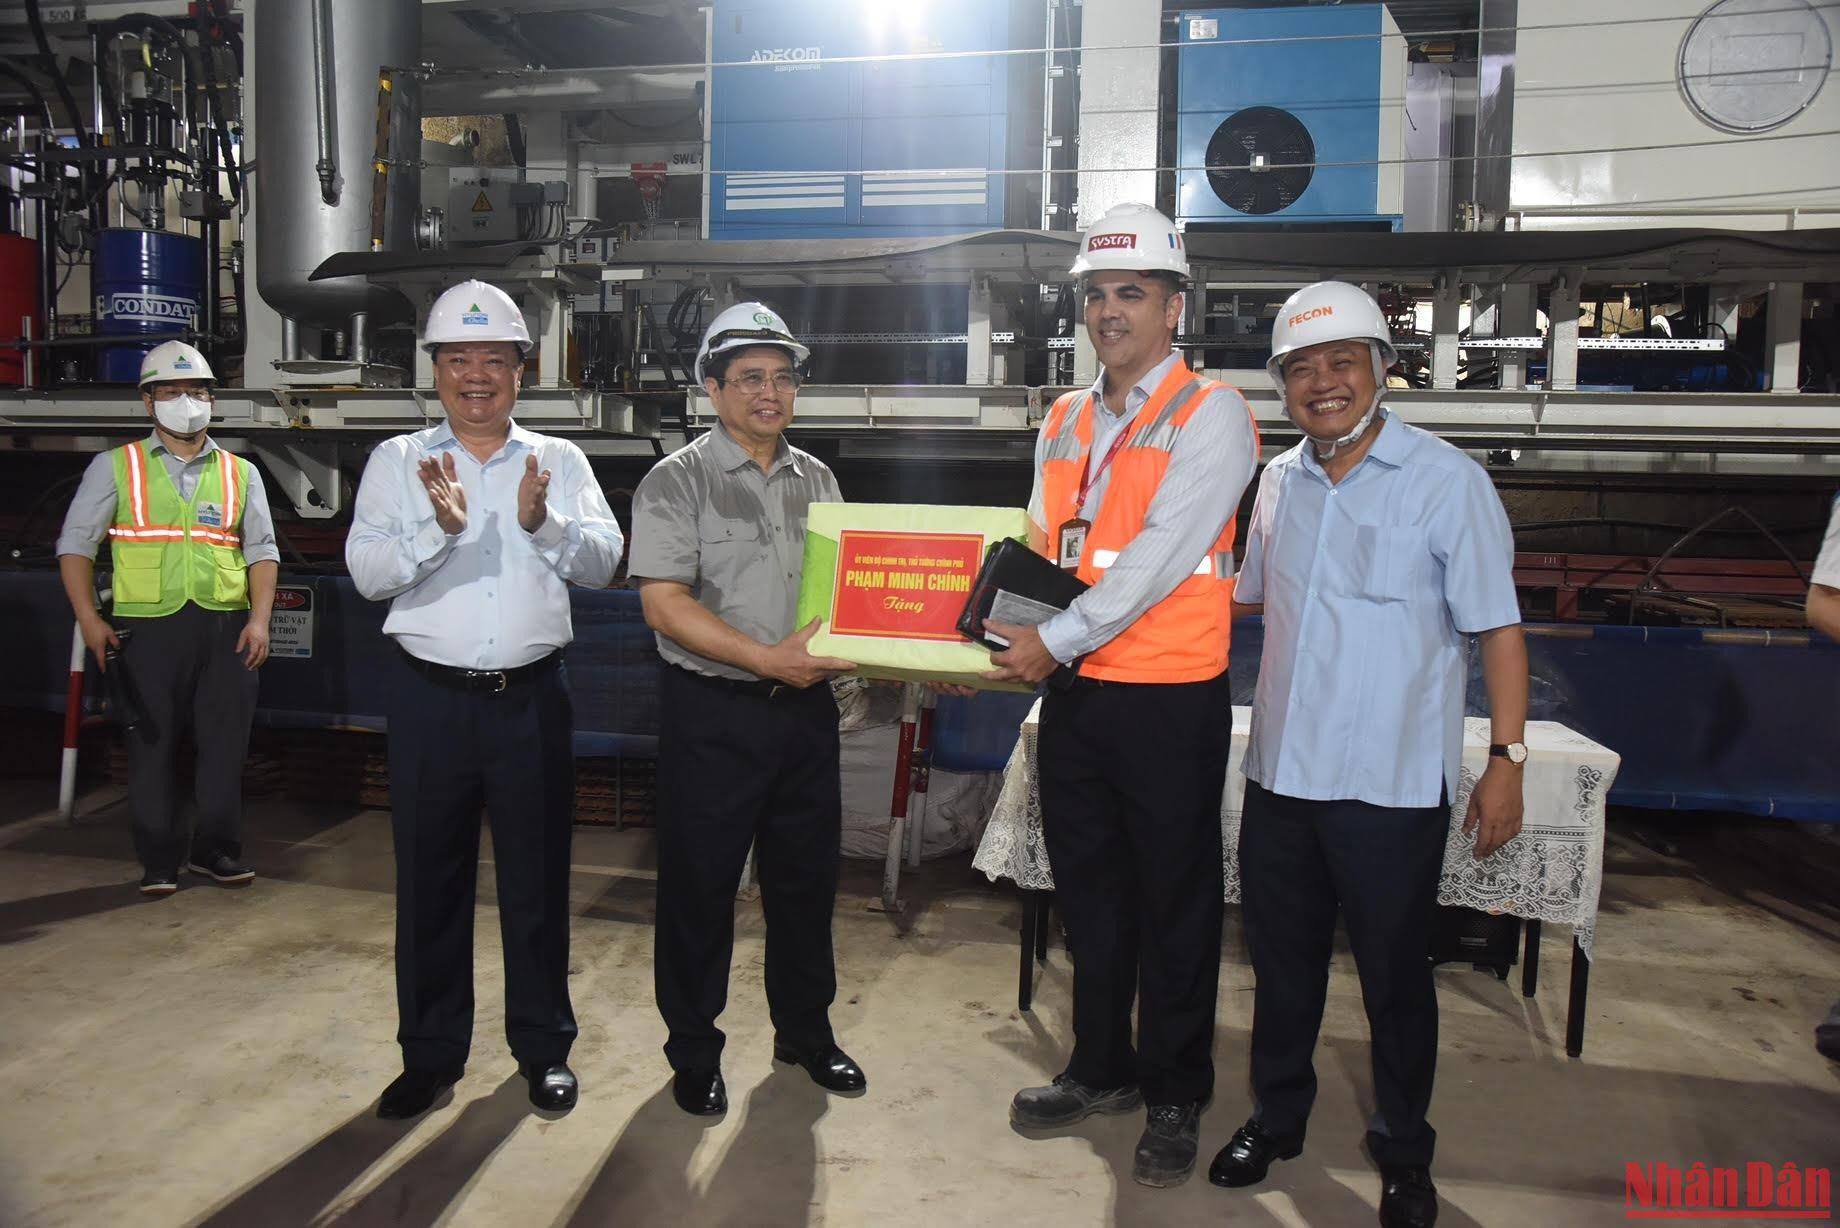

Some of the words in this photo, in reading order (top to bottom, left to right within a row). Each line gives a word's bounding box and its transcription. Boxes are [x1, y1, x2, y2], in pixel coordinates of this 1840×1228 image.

[750, 47, 821, 63] ADEKOM
[672, 153, 697, 165] SWL
[114, 299, 195, 319] CONDAT
[1288, 306, 1333, 328] FECON
[845, 570, 885, 591] PHẠM
[888, 572, 925, 590] MINH
[928, 571, 971, 592] CHÍNH
[883, 595, 925, 613] Tặng
